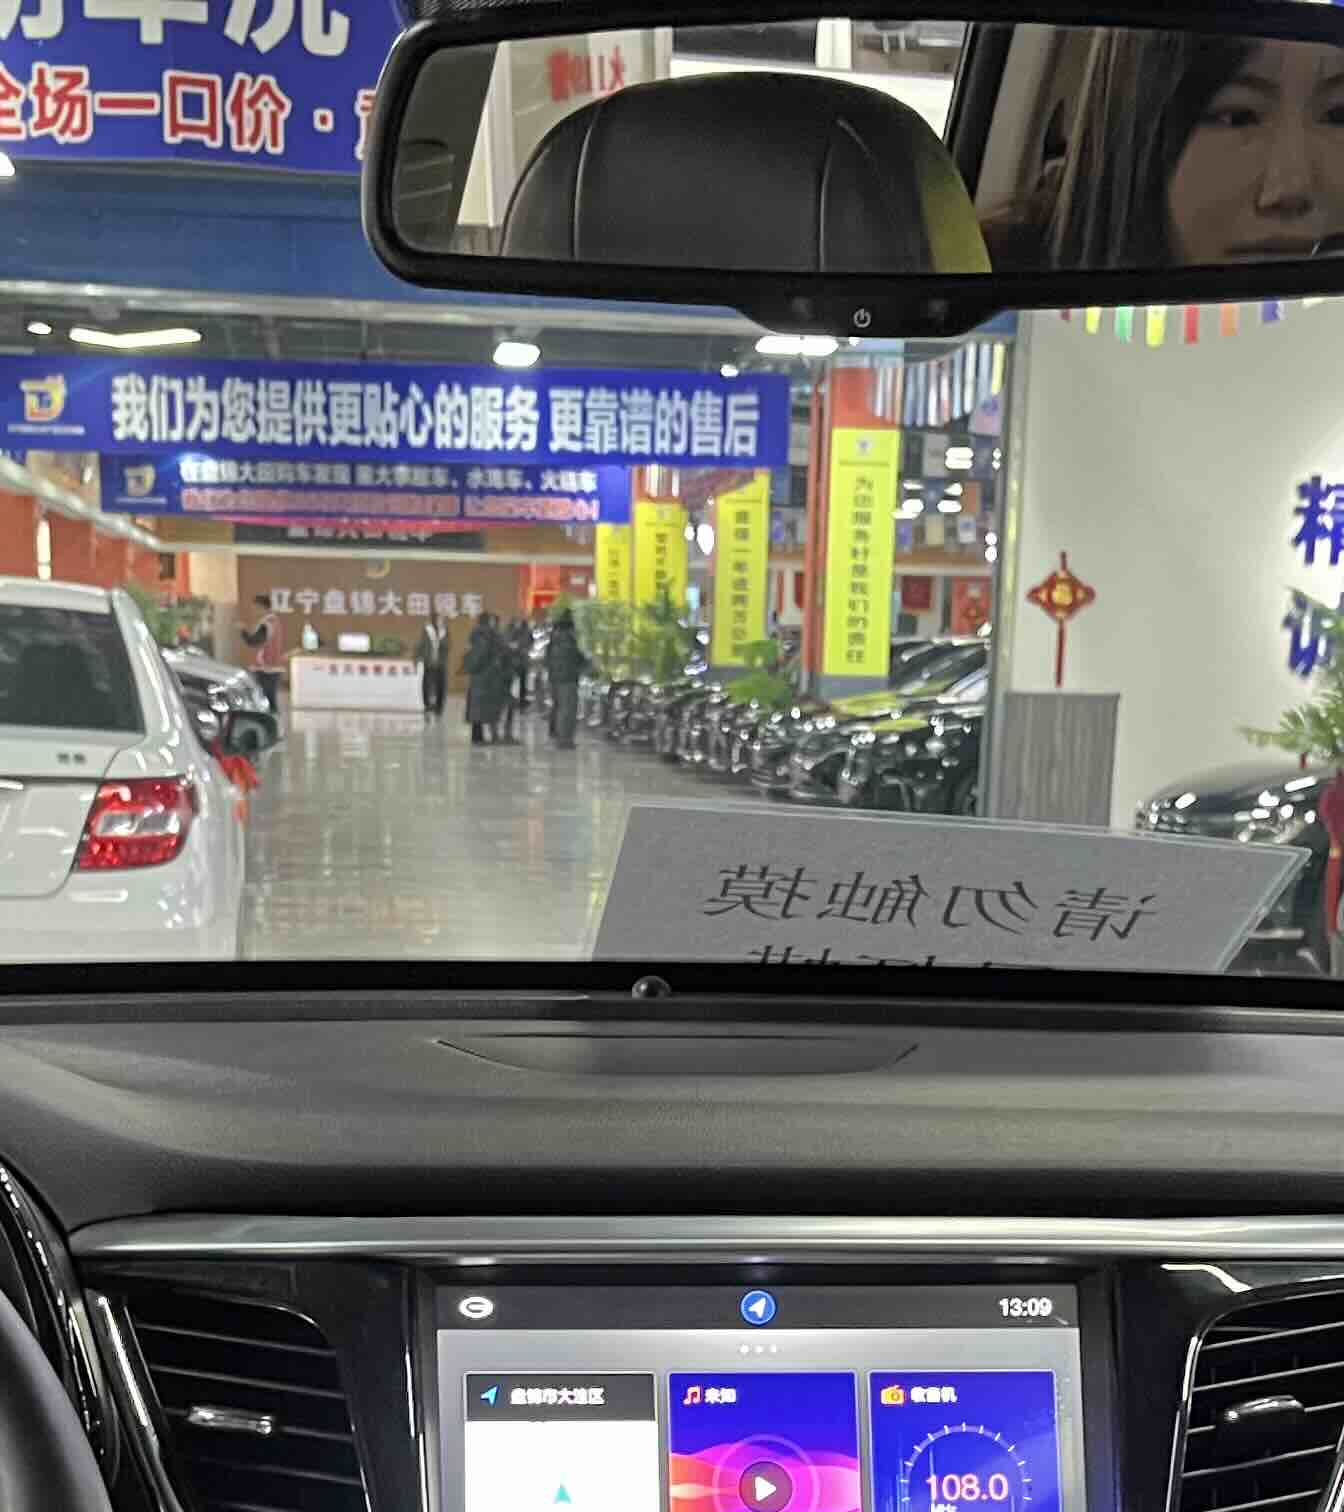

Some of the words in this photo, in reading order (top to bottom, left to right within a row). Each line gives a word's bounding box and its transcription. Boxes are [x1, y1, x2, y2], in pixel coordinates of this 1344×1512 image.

[111, 374, 540, 452] 我们为您提供更贴心的服务
[548, 387, 761, 458] 更靠谱的售后
[999, 1297, 1053, 1317] 13:09
[926, 1473, 1009, 1501] 108.0
